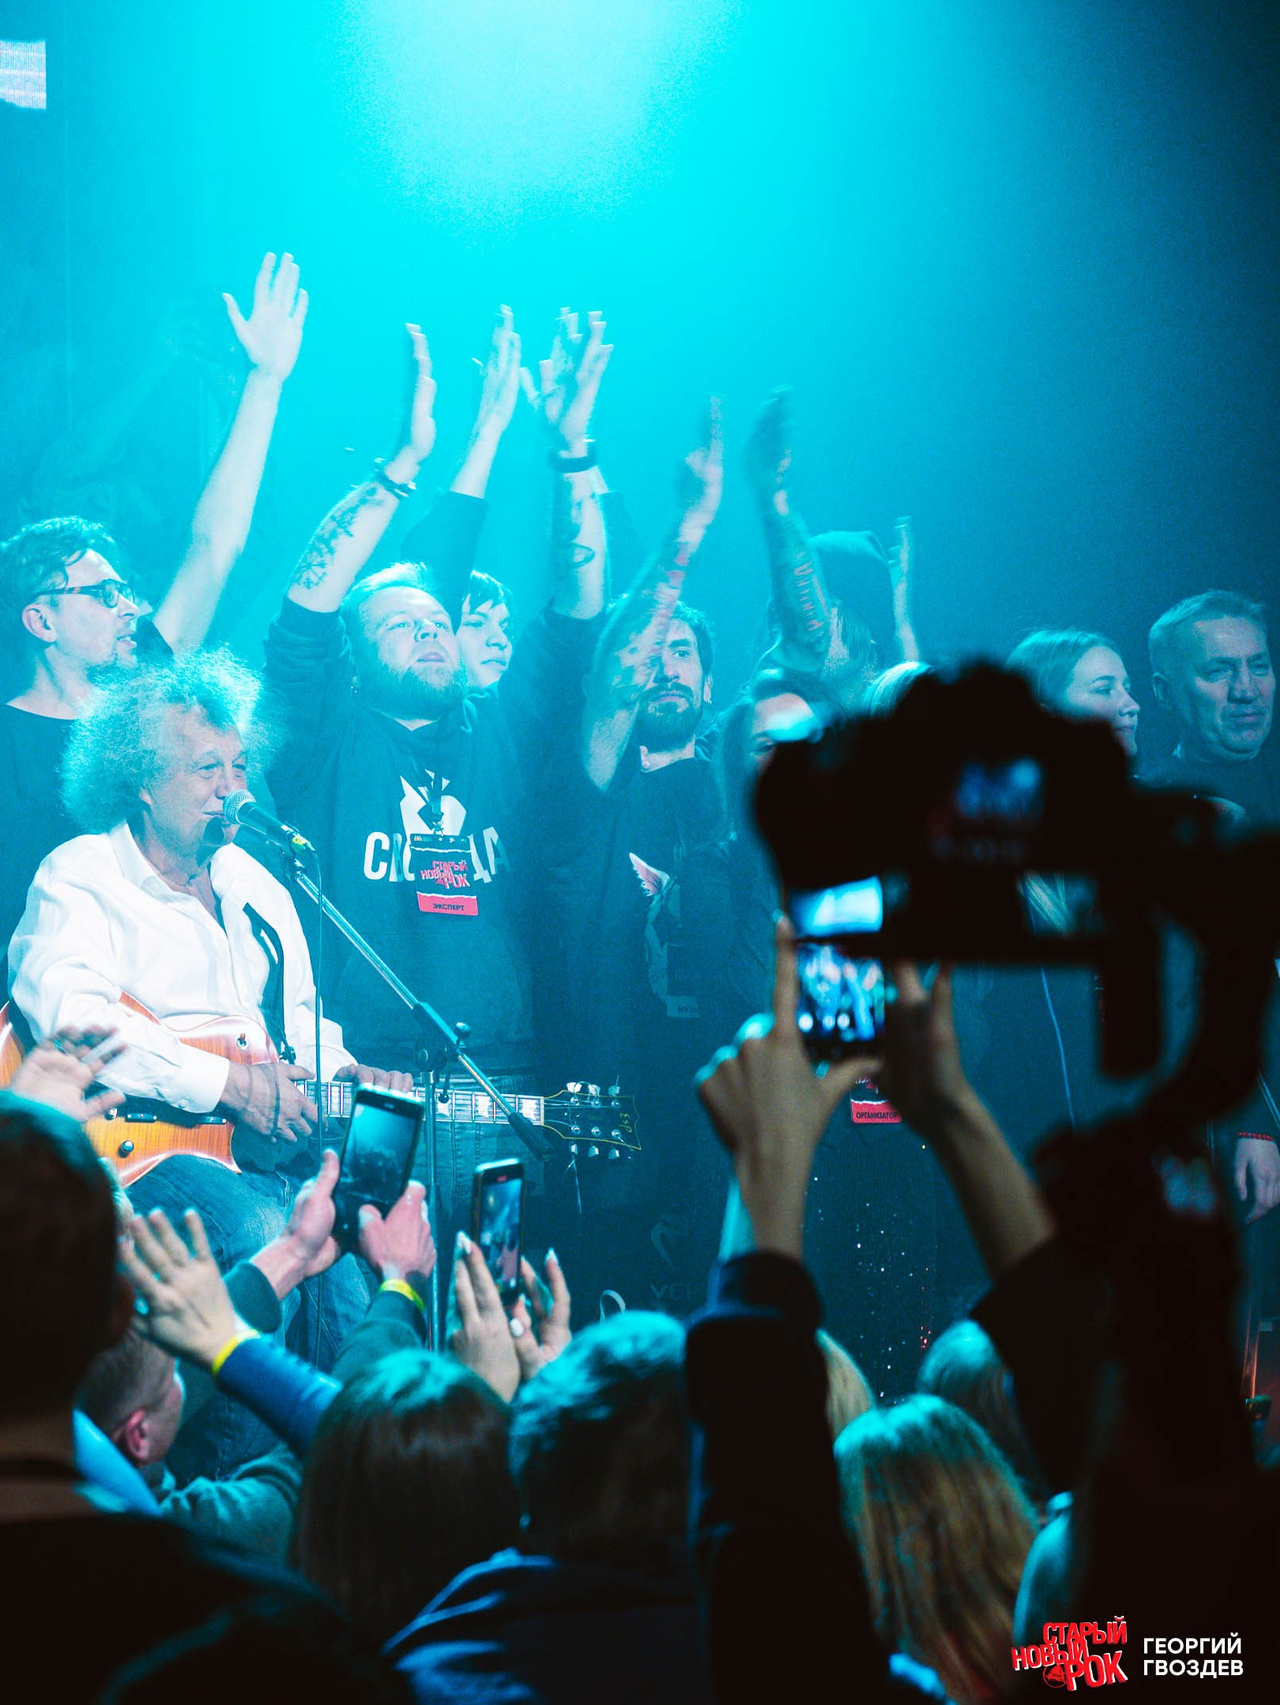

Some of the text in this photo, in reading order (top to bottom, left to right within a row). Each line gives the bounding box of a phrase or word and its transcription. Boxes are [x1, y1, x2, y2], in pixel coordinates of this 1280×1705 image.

[432, 860, 469, 873] СТАРЫЙ
[444, 873, 471, 890] РОК
[432, 902, 465, 912] ЭКСПЕРТ
